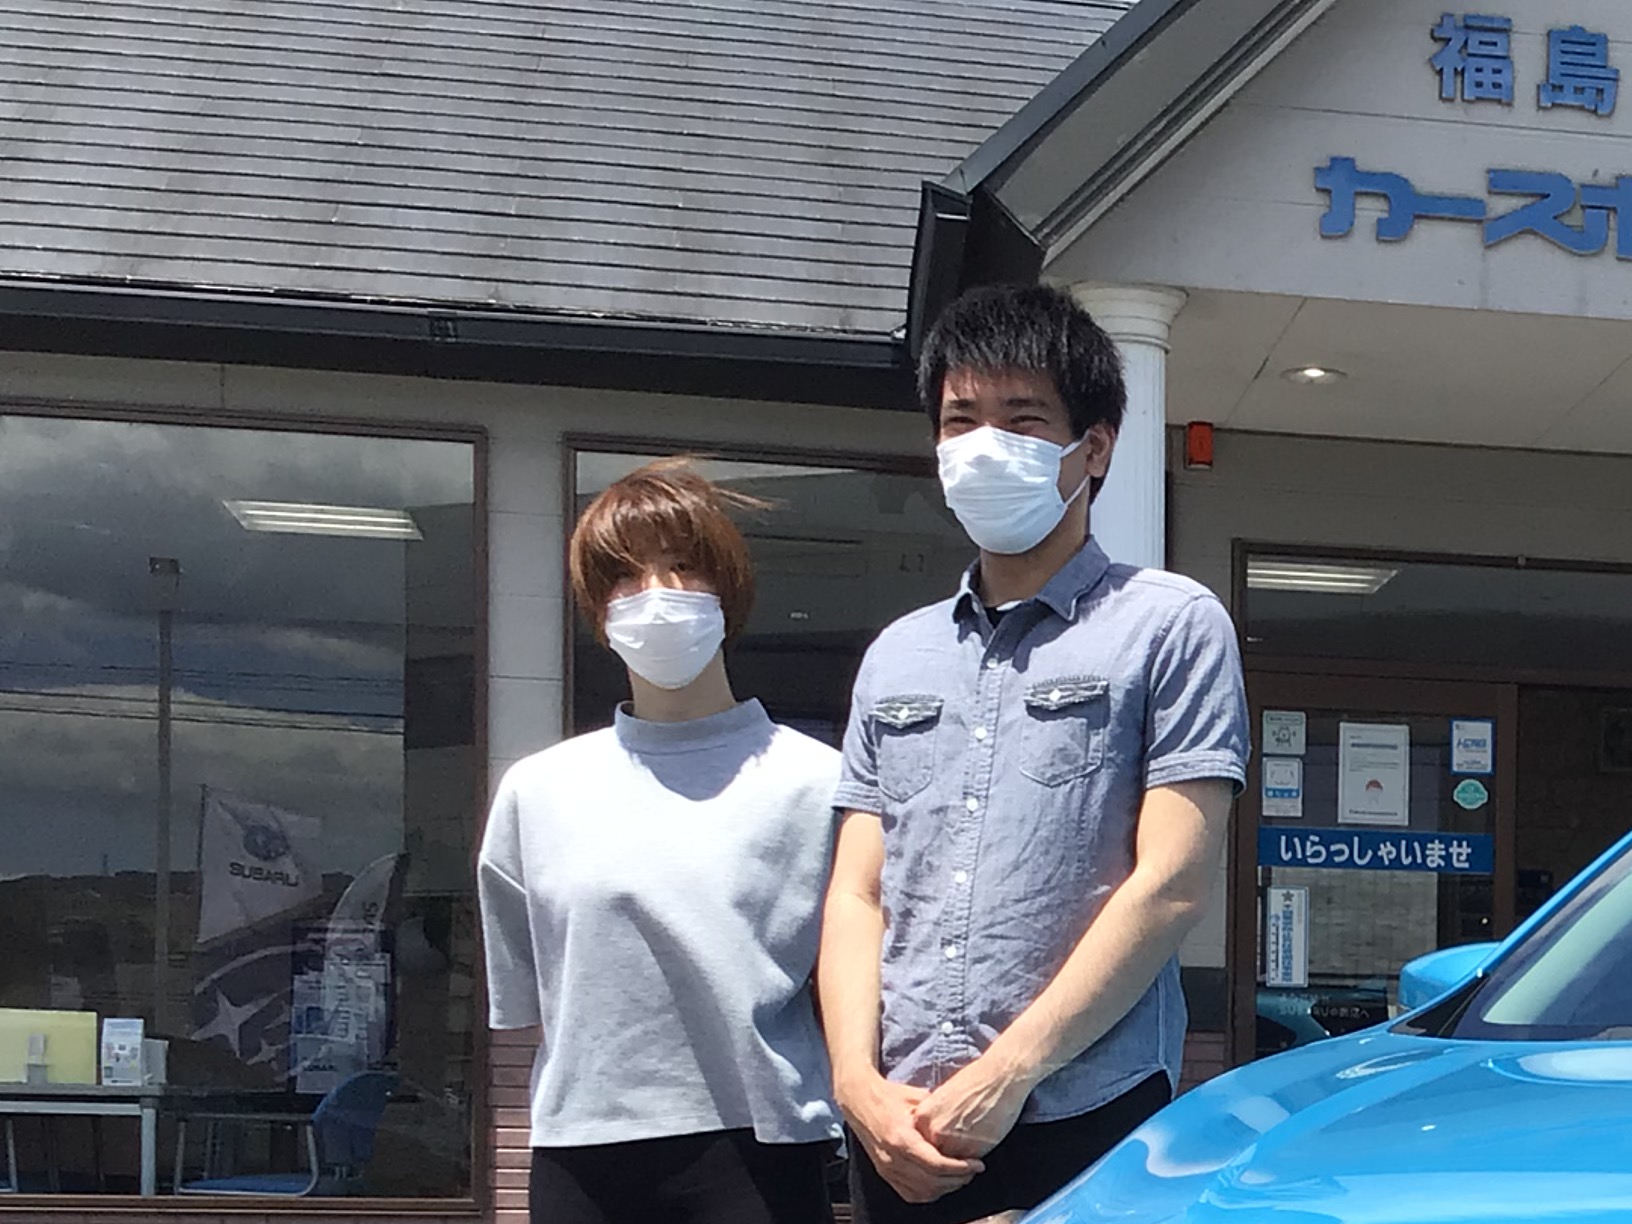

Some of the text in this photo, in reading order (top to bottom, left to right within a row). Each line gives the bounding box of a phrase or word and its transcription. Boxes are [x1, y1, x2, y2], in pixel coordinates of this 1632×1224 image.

[1280, 834, 1472, 868] いらっしゃいませ
[229, 861, 299, 887] SUBARU
